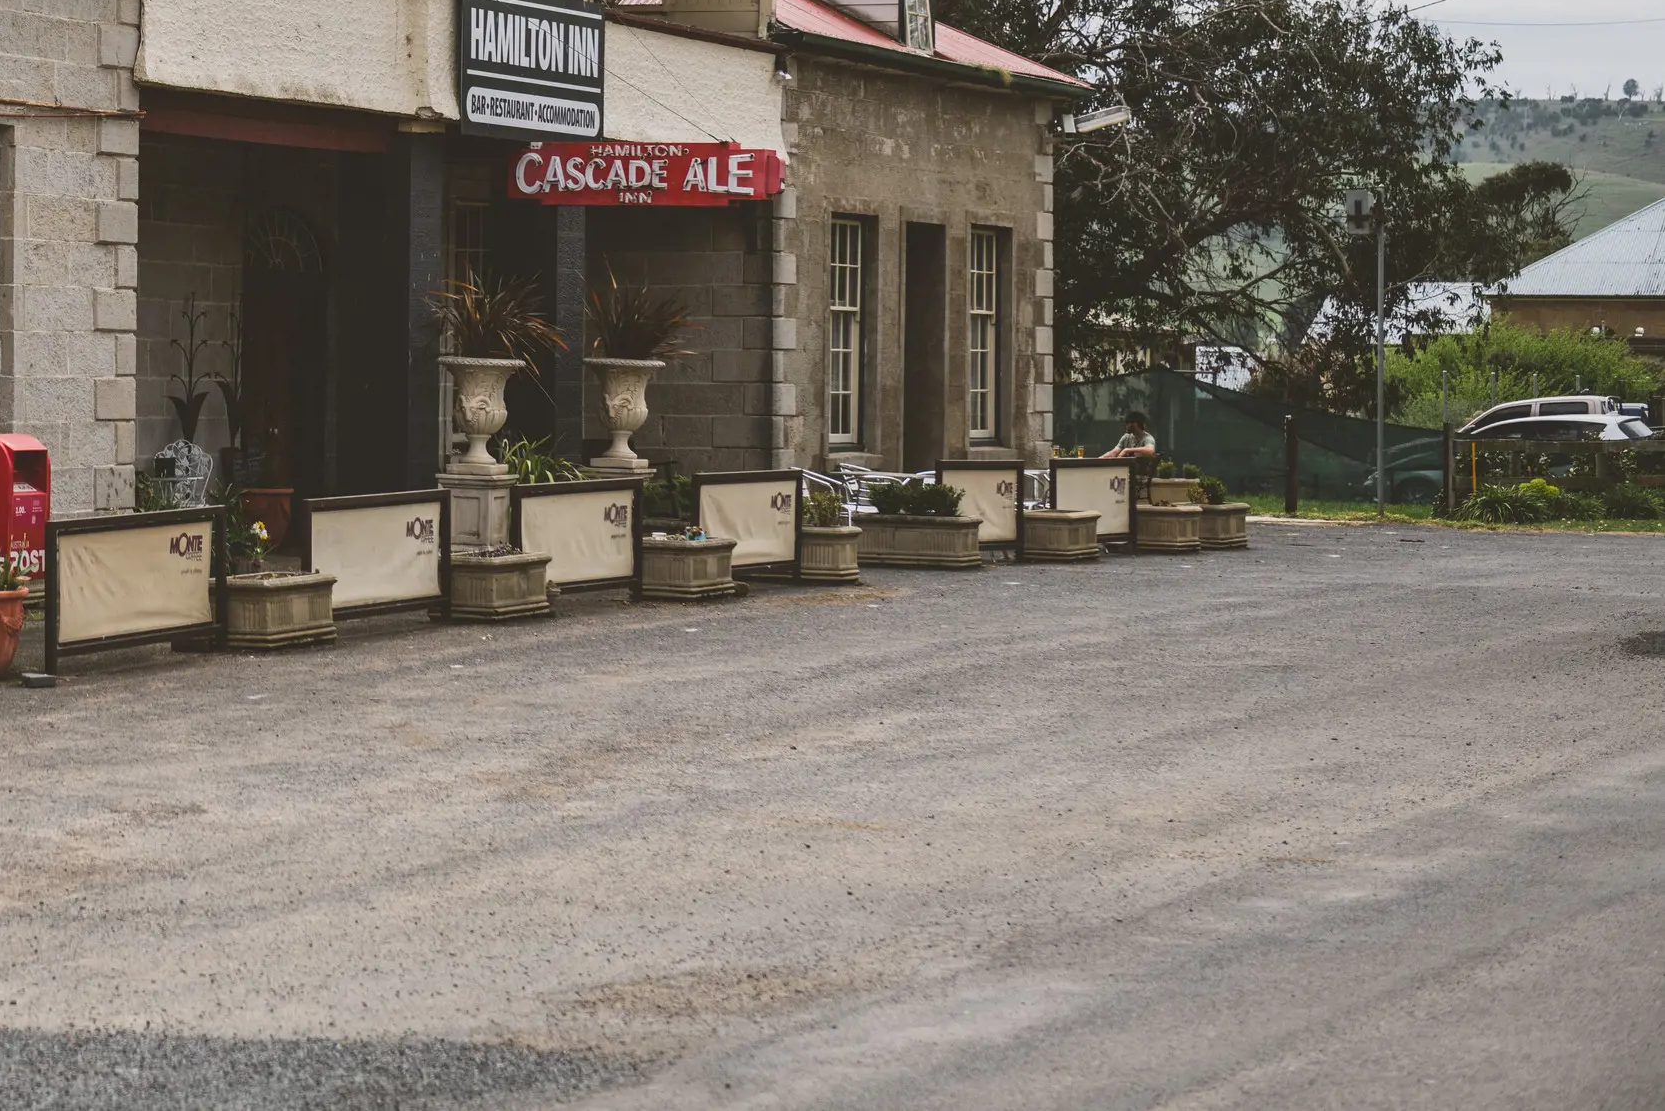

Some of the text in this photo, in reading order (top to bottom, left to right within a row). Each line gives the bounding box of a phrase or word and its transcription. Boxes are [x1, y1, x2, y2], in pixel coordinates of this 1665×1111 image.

[470, 7, 599, 78] HAMILTON INN
[471, 94, 596, 130] BAR RESTAURANT ACCOMMODATION
[590, 144, 682, 157] HAMILTON
[515, 152, 755, 195] CASCADE ALE
[618, 191, 653, 204] INN
[406, 517, 434, 540] MONTE
[169, 532, 203, 557] MONTE
[10, 549, 45, 574] POST
